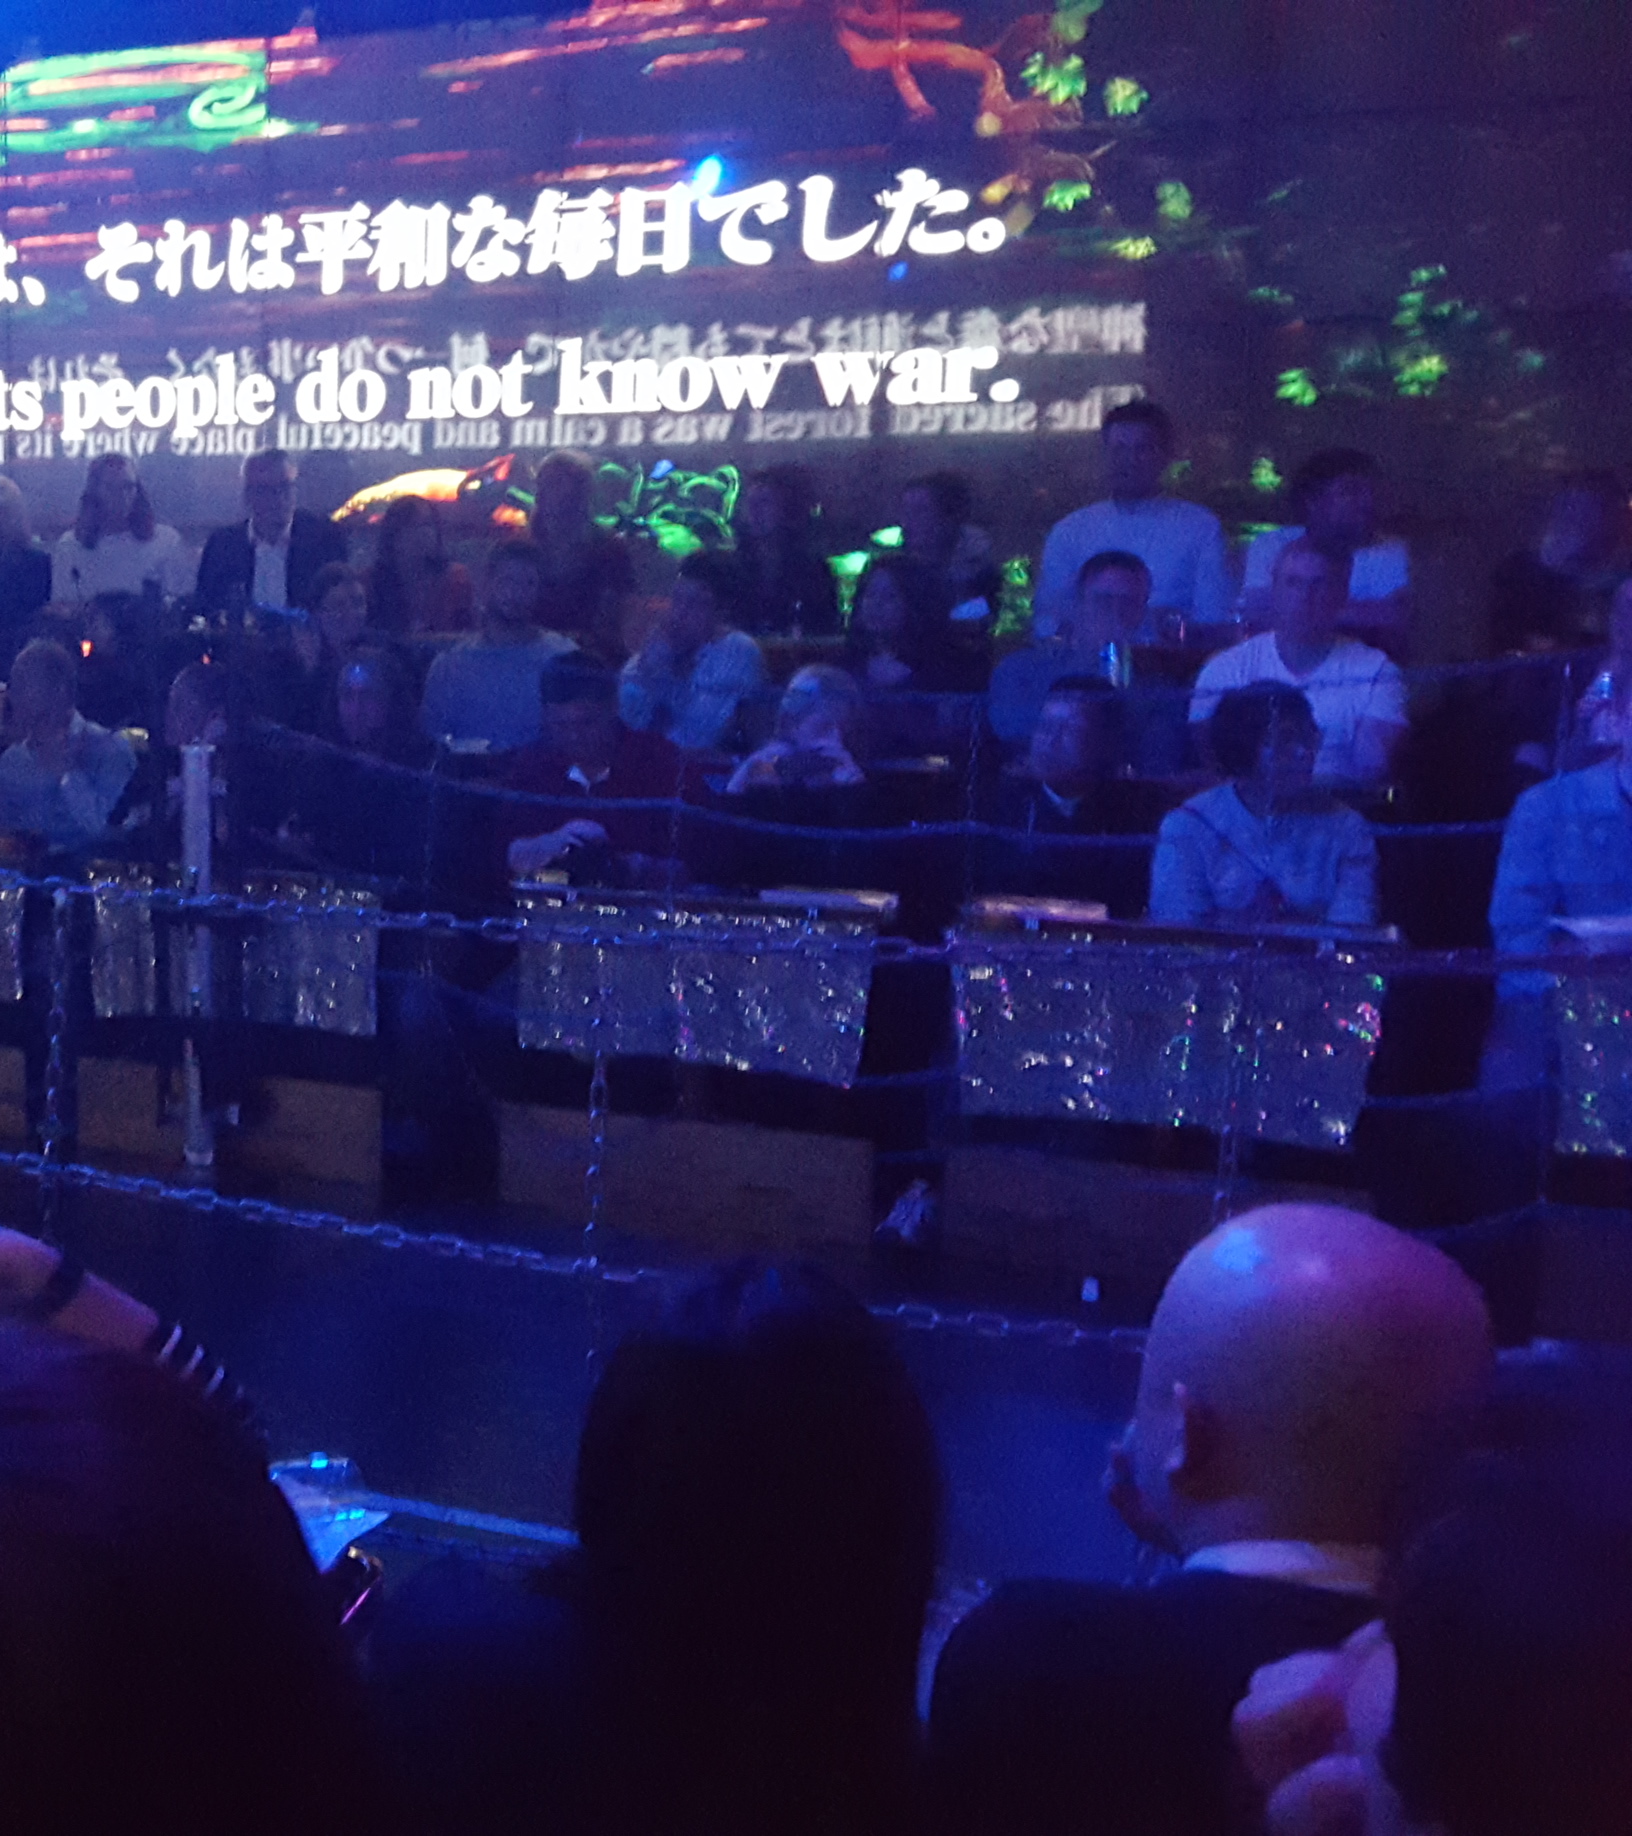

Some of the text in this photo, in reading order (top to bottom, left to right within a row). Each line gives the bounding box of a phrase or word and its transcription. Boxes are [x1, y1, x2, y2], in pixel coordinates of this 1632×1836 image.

[59, 349, 277, 457] people
[295, 345, 388, 424] do
[405, 336, 536, 421] not
[552, 336, 796, 417] know
[809, 341, 1022, 407] war.
